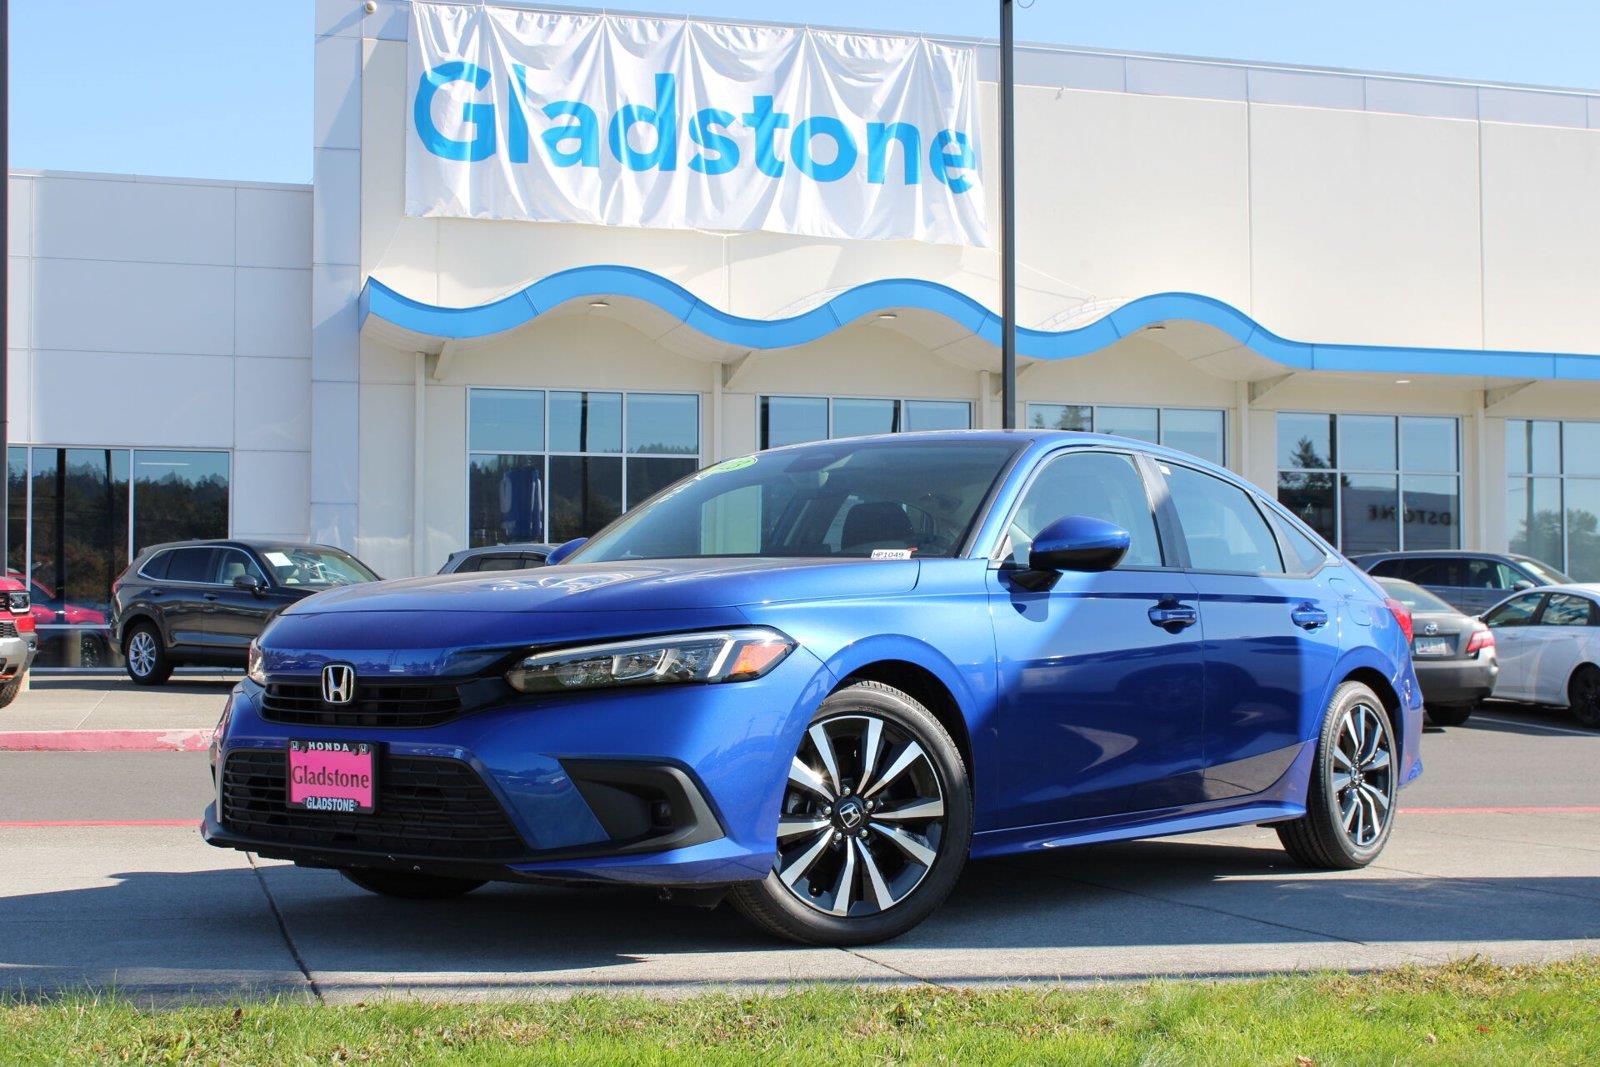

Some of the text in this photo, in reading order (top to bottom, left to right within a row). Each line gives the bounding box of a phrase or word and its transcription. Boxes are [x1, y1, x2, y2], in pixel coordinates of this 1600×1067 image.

[413, 61, 976, 194] Gladstone
[308, 741, 350, 752] HONDA
[292, 765, 369, 788] Gladstone
[306, 796, 354, 812] GLADSTONE
